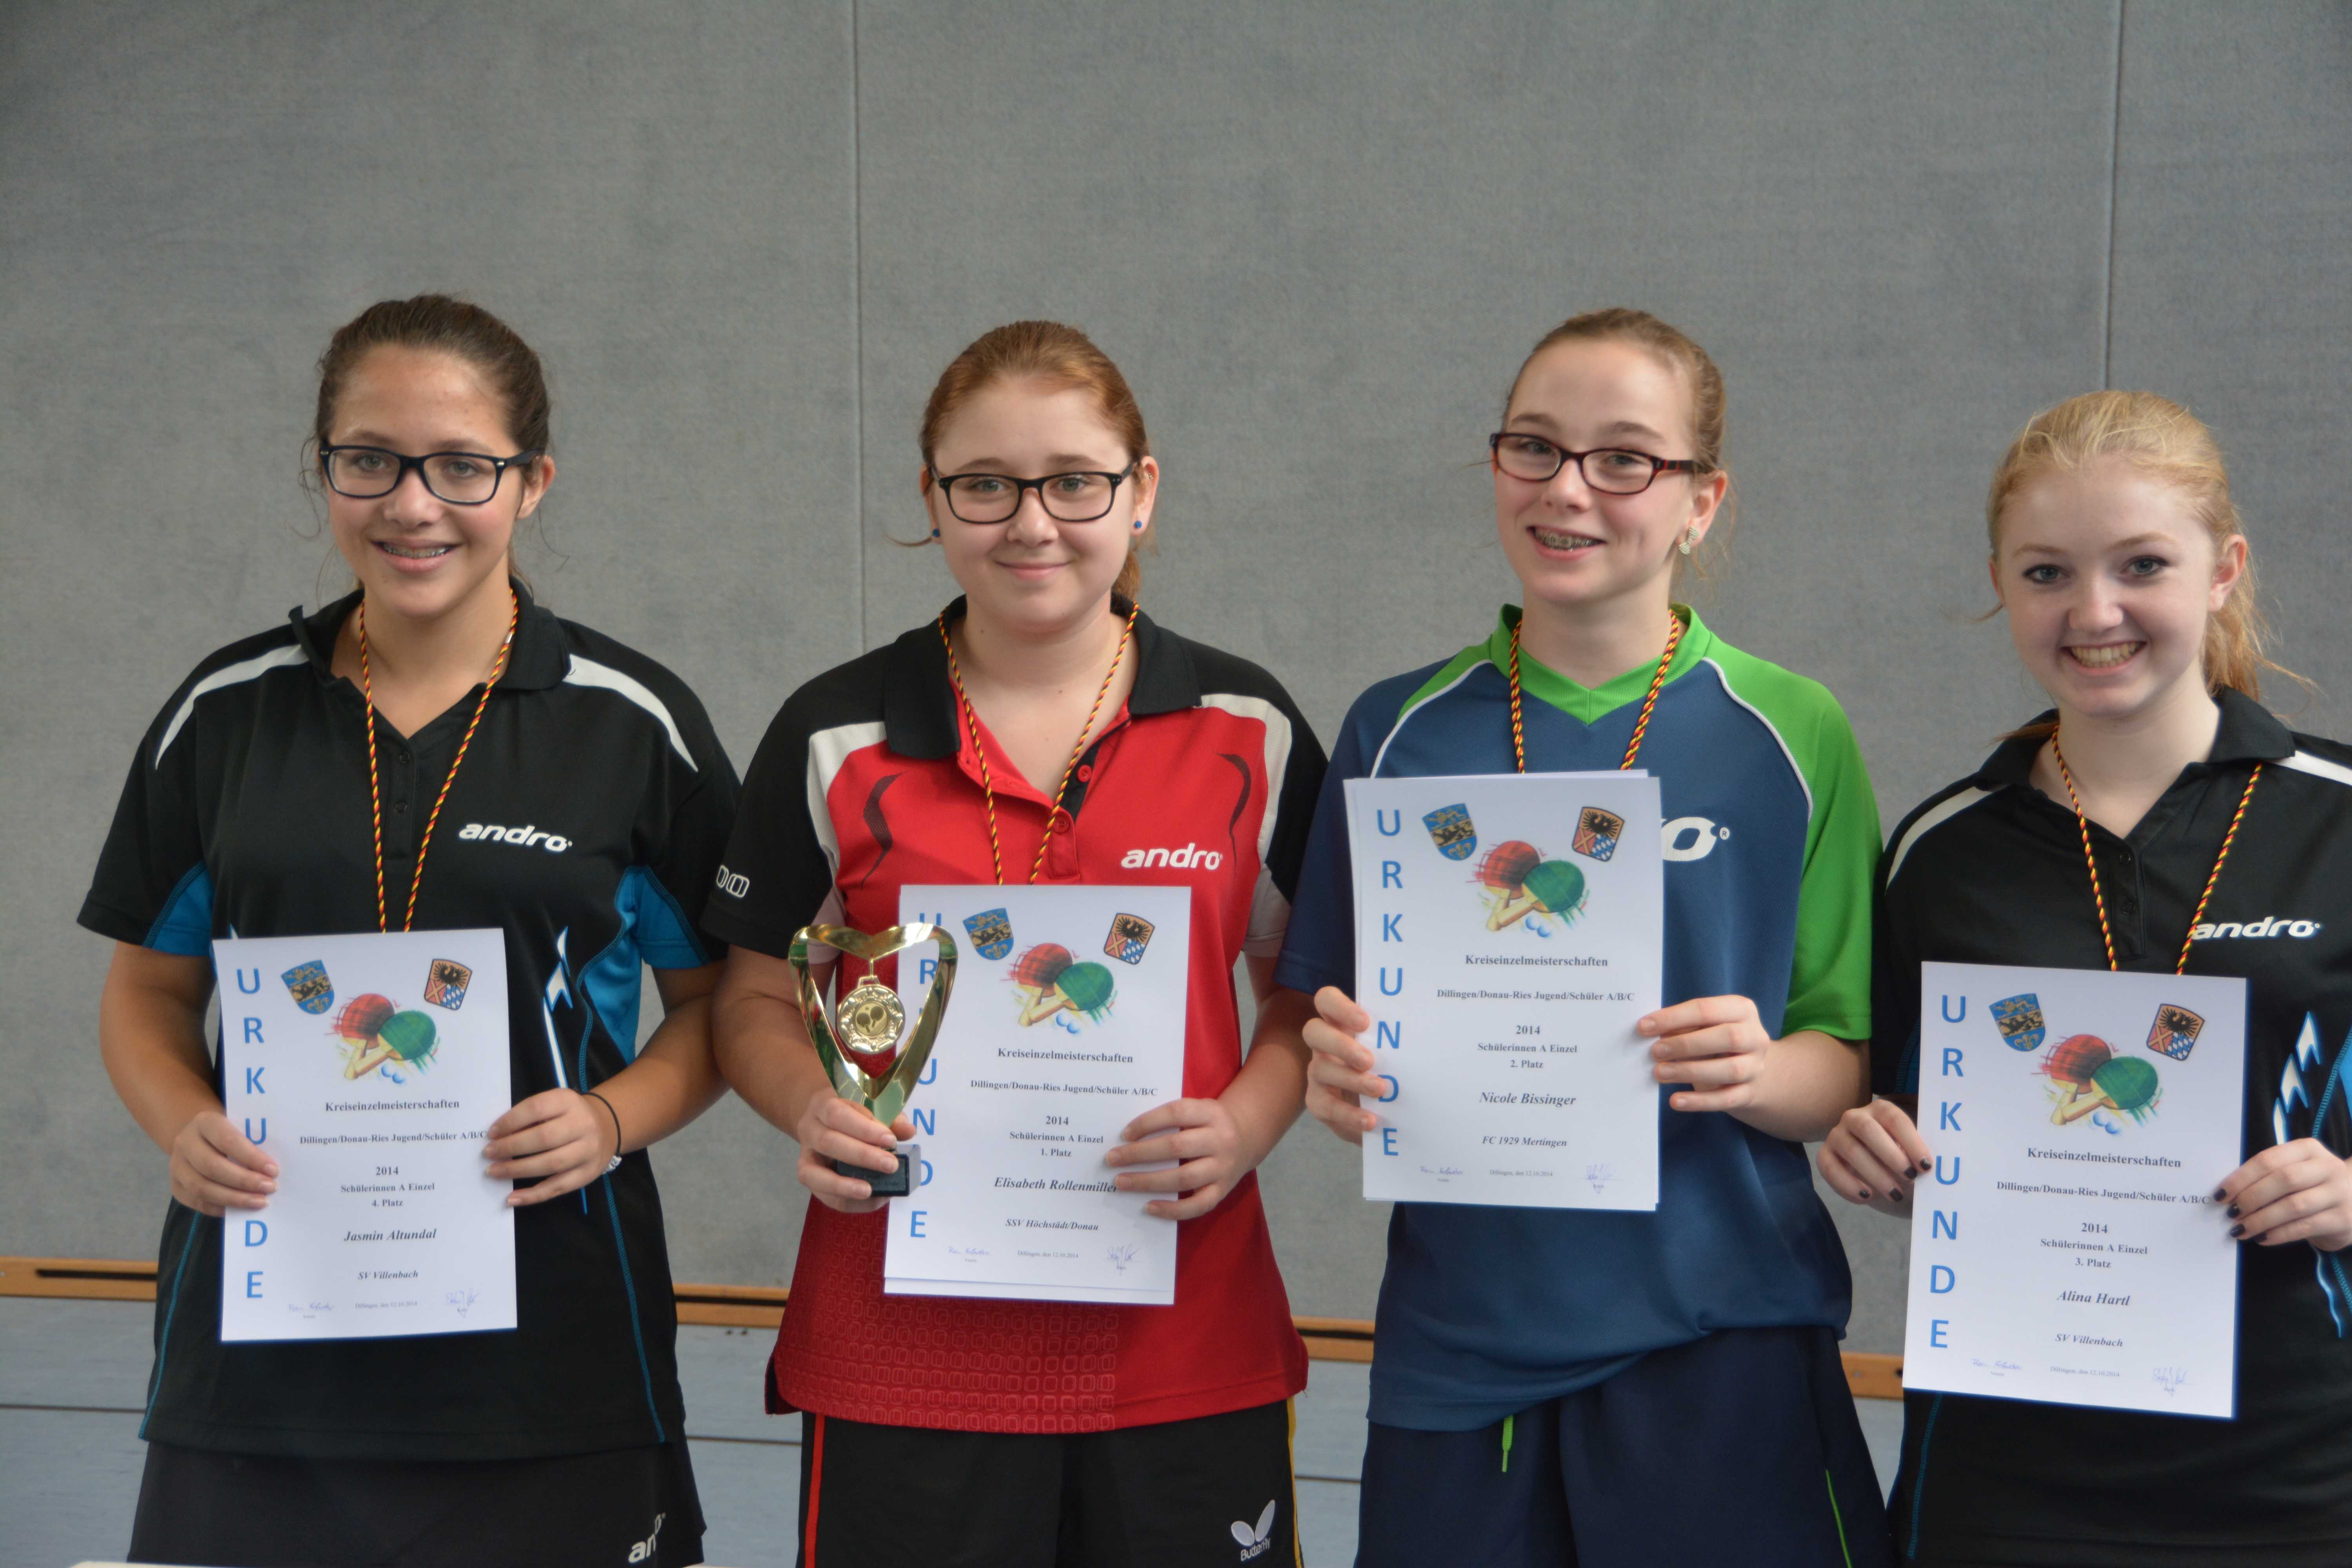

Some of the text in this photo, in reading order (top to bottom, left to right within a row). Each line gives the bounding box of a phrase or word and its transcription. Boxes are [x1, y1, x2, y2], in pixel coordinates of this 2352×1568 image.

[1465, 955, 1608, 966] Kreiseinzelmeisterschaften
[1437, 989, 1634, 1001] Dillingen/Donau-Ries Jugend/Schüler A/B/C
[1516, 1025, 1540, 1035] 2014
[1478, 1043, 1536, 1052] Schülerinnen
[1550, 1044, 1577, 1053] Einzel
[998, 1048, 1133, 1063] Kreiseinzelmeisterschaften
[1510, 1060, 1543, 1068] 2. Platz
[971, 1080, 1060, 1091] Dillingen/Donau-Ries
[1063, 1084, 1129, 1094] Jugend/Schüler
[326, 1100, 459, 1111] Kreiseinzelmeisterschaften
[1479, 1092, 1576, 1107] Nicole Bissinger
[1046, 1116, 1069, 1125] 2014
[237, 968, 268, 1298] URKUDE
[300, 1131, 486, 1145] Dillingen/Donau-Ries Jugend/Schüler A/B/C
[1009, 1132, 1065, 1141] Schülerinnen
[1078, 1135, 1103, 1143] Einzel
[1482, 1136, 1567, 1148] FC 1929 Mertingen
[1041, 1148, 1071, 1157] 1. Platz
[2028, 1148, 2181, 1168] Kreiseinzelmeisterschaften
[376, 1166, 399, 1176] 2014
[1930, 995, 1966, 1348] URKUNDE
[341, 1185, 396, 1193] Schülerinnen
[409, 1183, 435, 1191] Einzel
[994, 1177, 1045, 1189] Elisabeth
[1997, 1181, 2210, 1205] Dillingen/Donau-Ries Jugend/Schüler A/B/C
[1005, 1219, 1099, 1230] SSV Höchstädt/Donau
[2082, 1223, 2108, 1234] 2014
[344, 1229, 437, 1241] Jasmin Altundal
[2041, 1239, 2103, 1251] Schülerinnen
[2118, 1245, 2147, 1254] Einzel
[2075, 1258, 2111, 1268] 3. Platz
[374, 1270, 418, 1279] Villenbach
[2057, 1290, 2131, 1306] Alina Hartl
[2073, 1335, 2123, 1347] Villenbach
[1240, 1538, 1270, 1561] Butterfly
